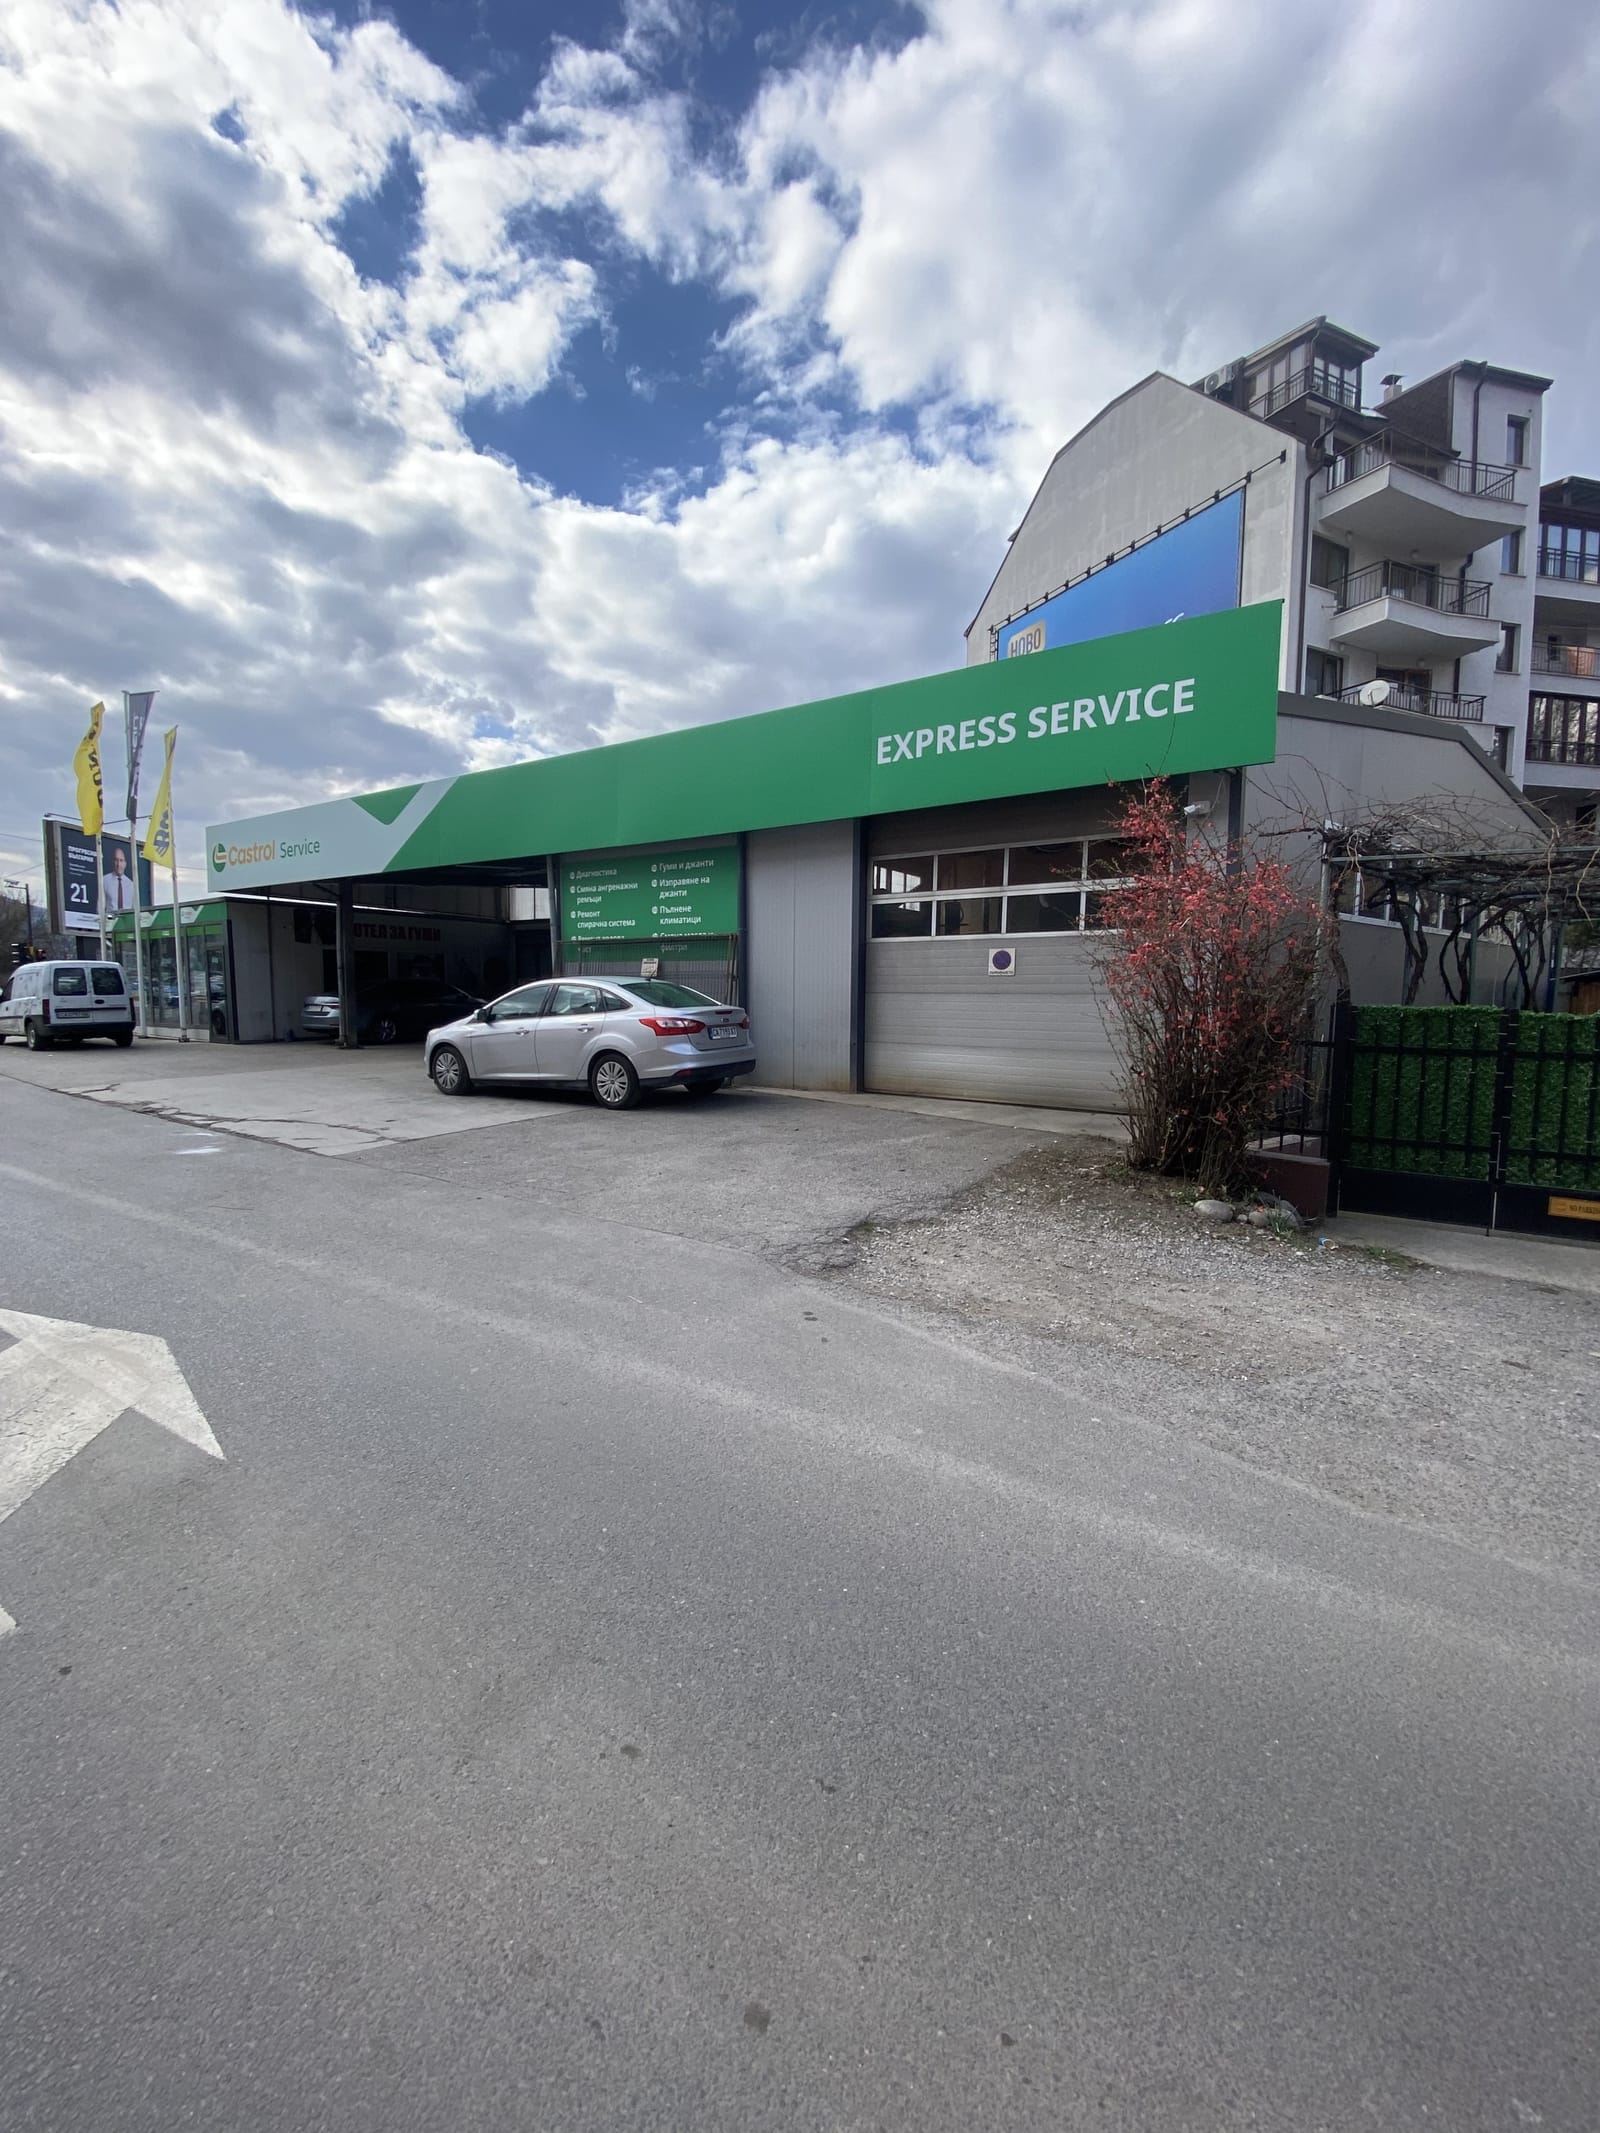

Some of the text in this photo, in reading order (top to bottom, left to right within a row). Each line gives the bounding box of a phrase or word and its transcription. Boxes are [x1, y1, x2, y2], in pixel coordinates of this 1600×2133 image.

[877, 678, 1195, 765] EXPRESS SERVICE
[228, 839, 320, 866] Castrol Service
[659, 863, 677, 872] Гуми
[684, 859, 714, 871] джанти
[576, 868, 617, 879] Диагностика
[659, 876, 710, 887] Изправяне на
[70, 883, 89, 903] 21
[577, 882, 638, 893] Смяна ангренажни
[577, 895, 602, 905] ремъци
[659, 890, 687, 900] джанти
[577, 911, 600, 919] Ремонт
[659, 905, 692, 914] Пълнене
[577, 918, 635, 930] спирачна система
[660, 916, 702, 926] климатици
[352, 923, 387, 939] ОТЕЛ
